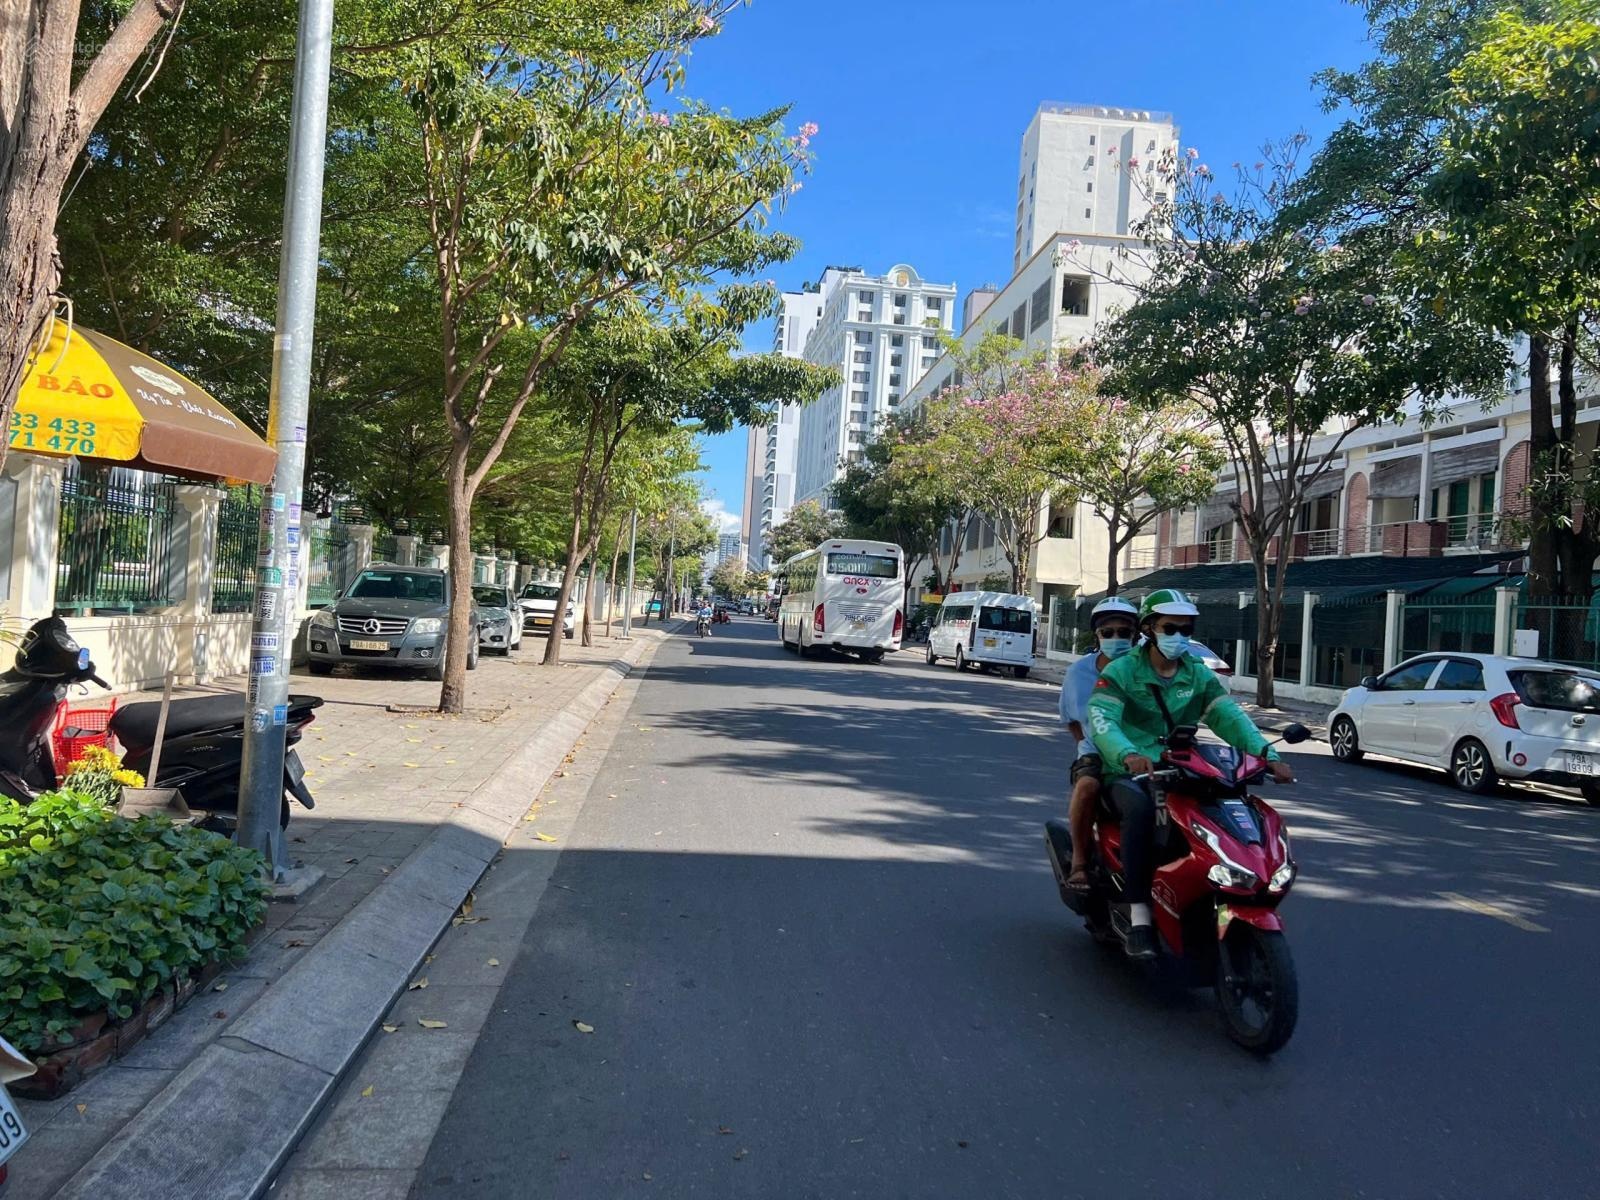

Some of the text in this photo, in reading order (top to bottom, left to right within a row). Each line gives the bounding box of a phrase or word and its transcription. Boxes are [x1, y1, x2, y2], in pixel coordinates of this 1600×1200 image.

[48, 417, 96, 437] 433
[46, 434, 95, 454] 470
[842, 576, 870, 586] anex
